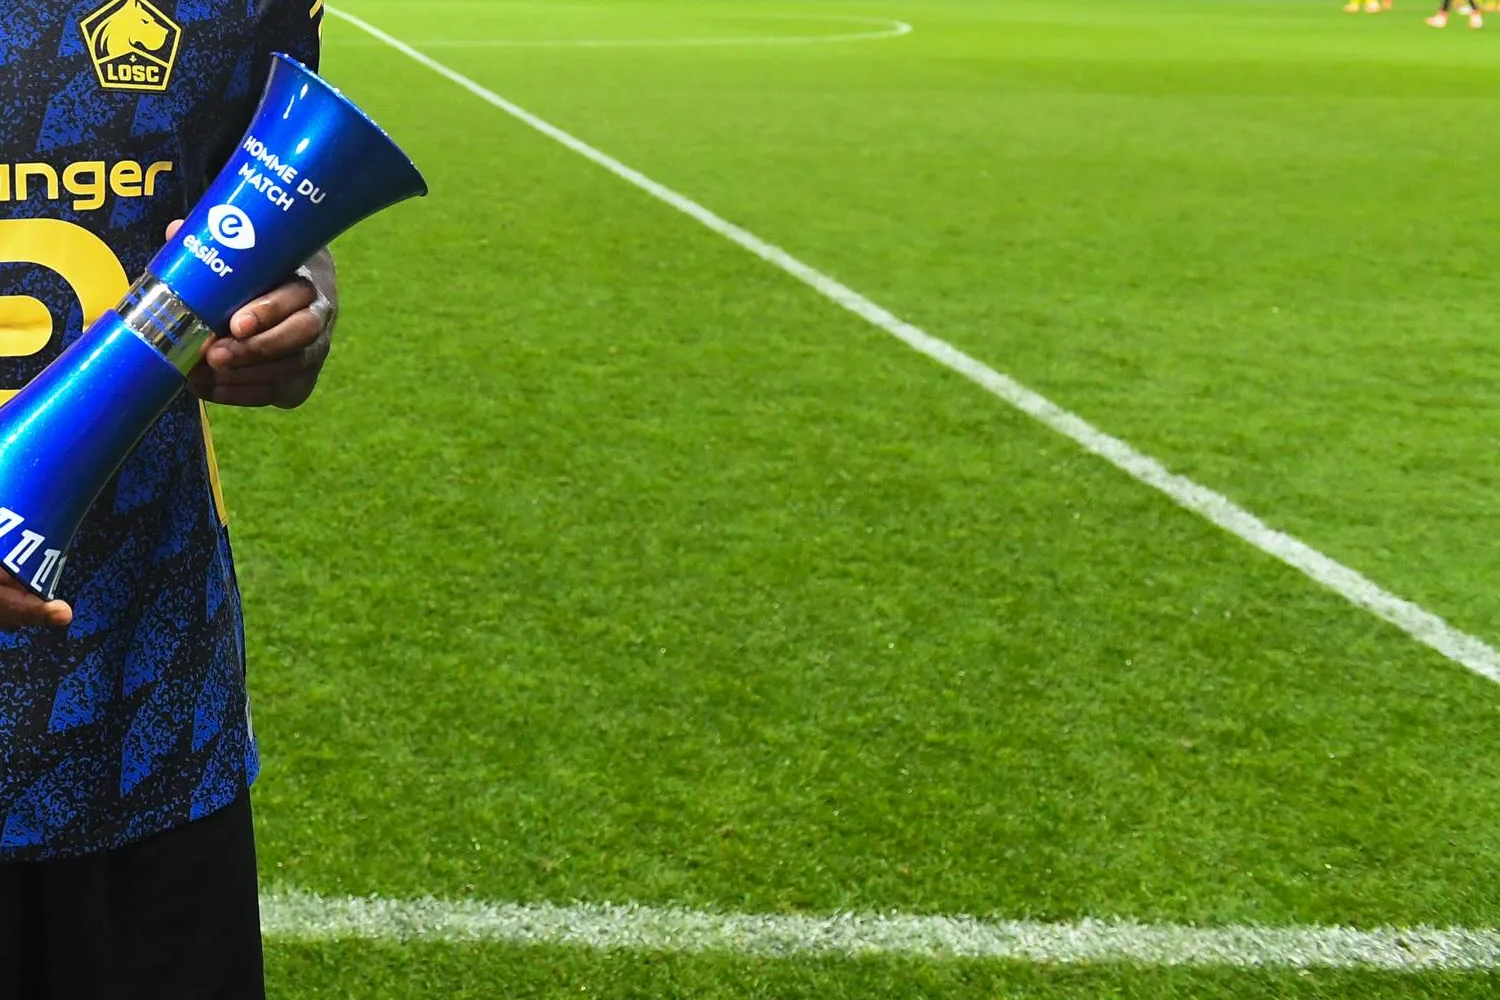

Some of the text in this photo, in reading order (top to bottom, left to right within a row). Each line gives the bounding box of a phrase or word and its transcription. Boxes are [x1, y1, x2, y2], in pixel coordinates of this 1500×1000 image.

[107, 63, 160, 83] LOSC
[238, 162, 295, 212] MATCH
[243, 135, 326, 204] HOMME DU
[183, 234, 233, 278] essilor
